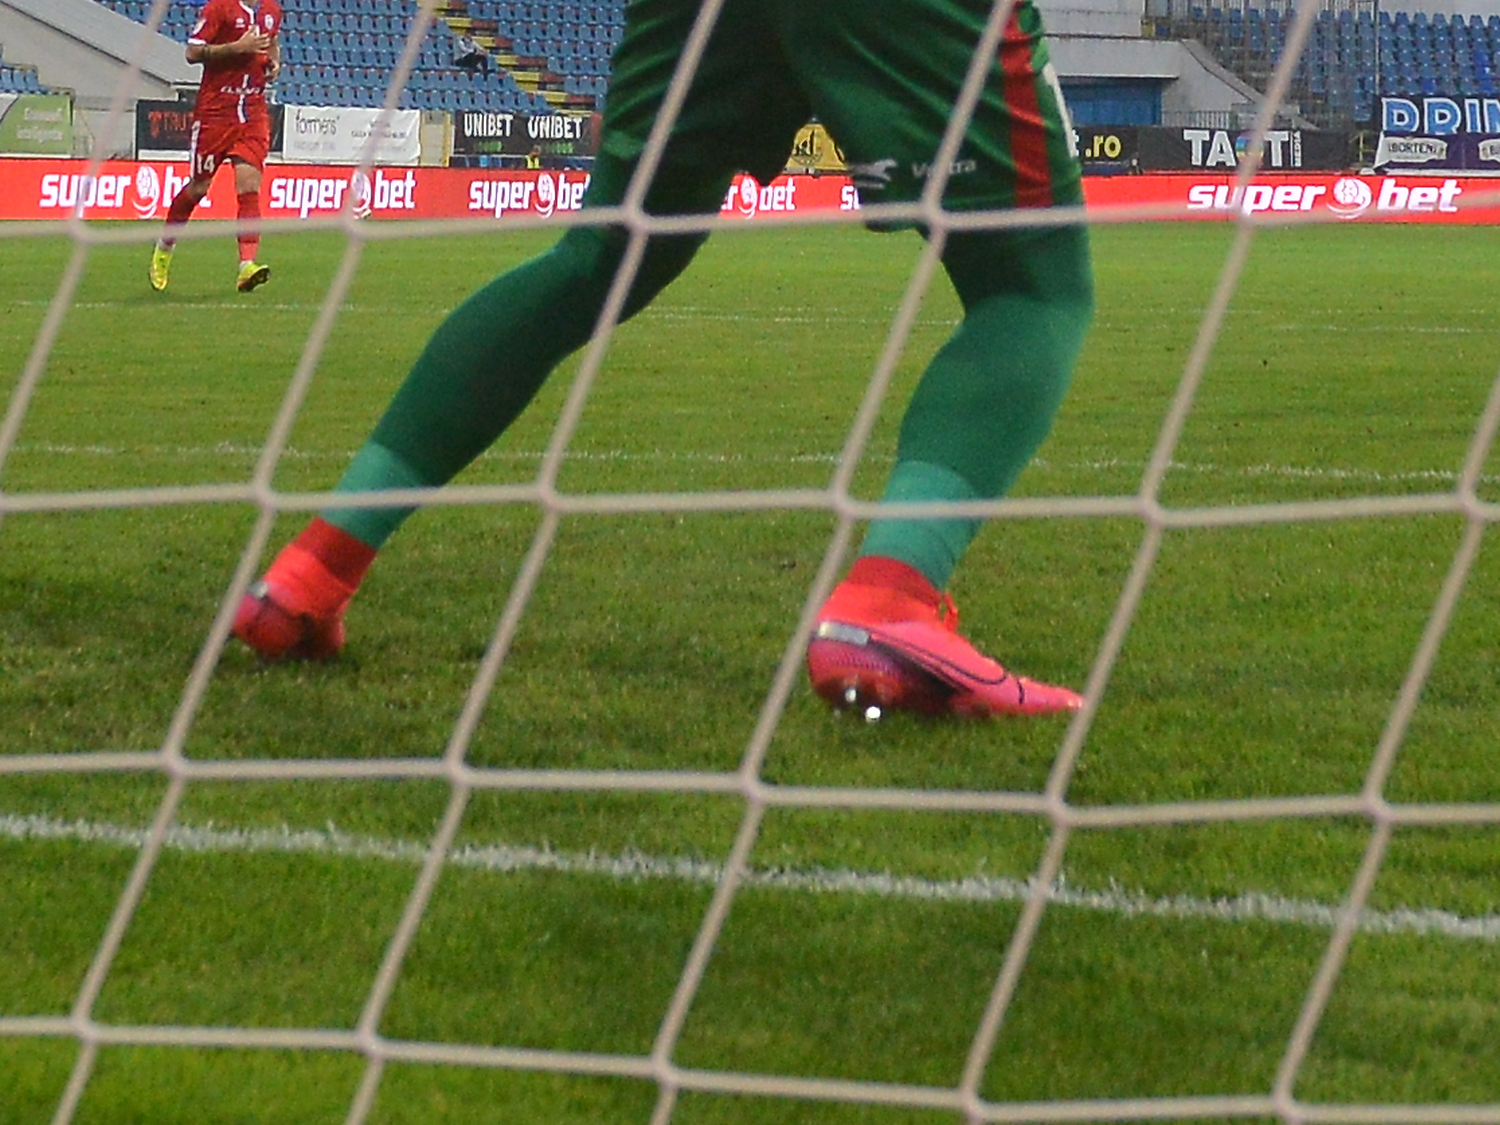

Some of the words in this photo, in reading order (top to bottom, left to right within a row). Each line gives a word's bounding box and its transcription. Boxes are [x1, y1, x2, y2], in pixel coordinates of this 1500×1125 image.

[464, 112, 514, 137] UNIBET
[527, 114, 583, 139] UNIBET
[196, 152, 215, 174] 14
[39, 174, 131, 218] super
[270, 177, 347, 218] super
[374, 170, 416, 208] bet
[468, 180, 535, 219] super
[1187, 183, 1326, 216] super
[1376, 179, 1463, 213] bet
